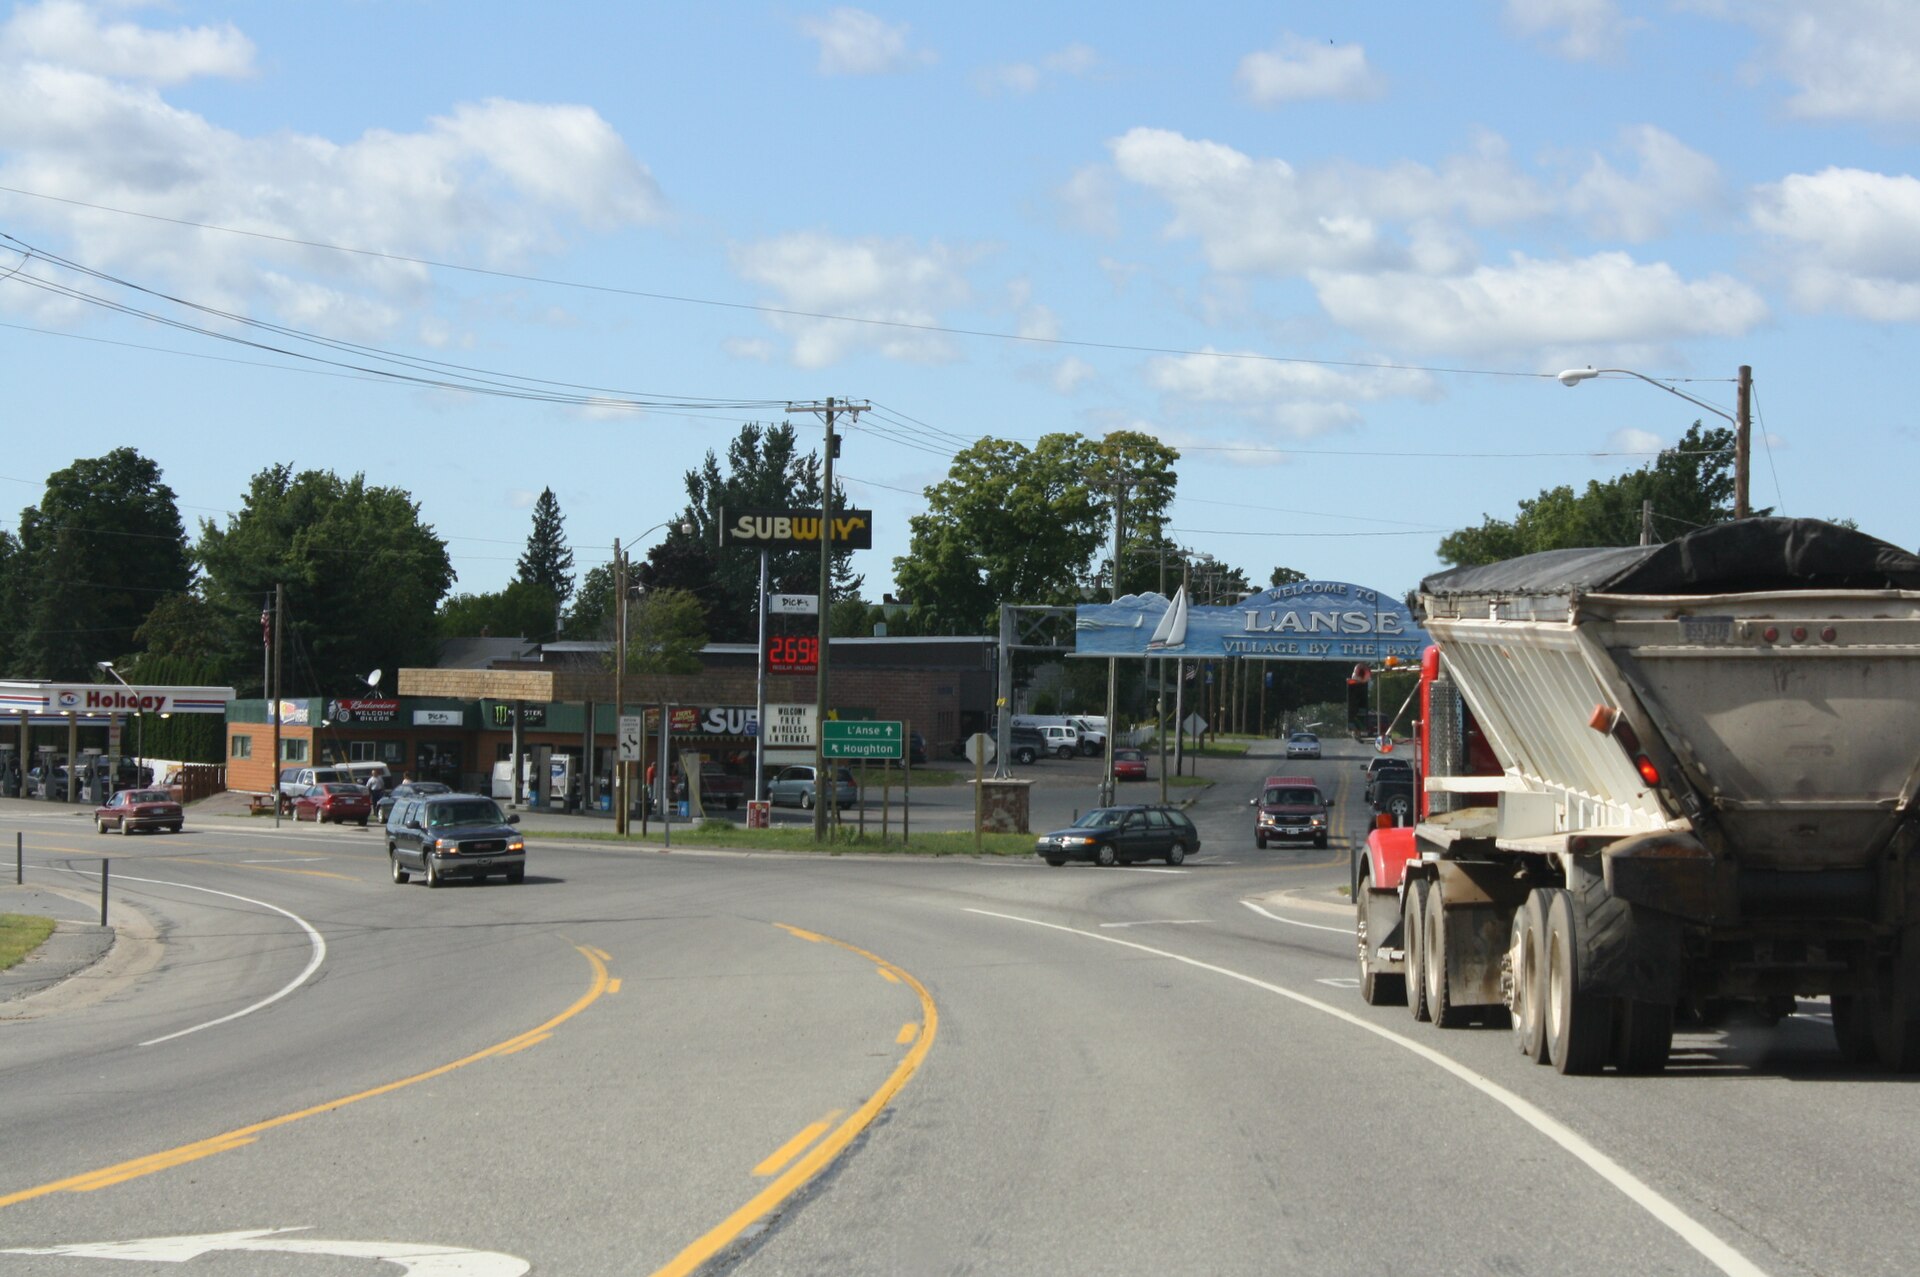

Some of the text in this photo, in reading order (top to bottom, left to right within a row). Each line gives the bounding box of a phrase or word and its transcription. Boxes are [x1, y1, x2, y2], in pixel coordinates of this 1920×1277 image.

[1268, 583, 1376, 602] WELCOME TO
[1244, 610, 1405, 635] L'ANSE
[1223, 640, 1421, 657] VILLAGE BY THE BAY
[86, 691, 166, 712] Holiday
[350, 700, 397, 710] Budweiser
[508, 709, 542, 717] MSTER
[778, 707, 806, 716] WELCOME
[781, 716, 801, 725] FREE
[772, 726, 807, 734] WIRELESS
[847, 726, 880, 735] L'Anse
[769, 735, 810, 743] INTERNET
[843, 744, 893, 755] Houghton
